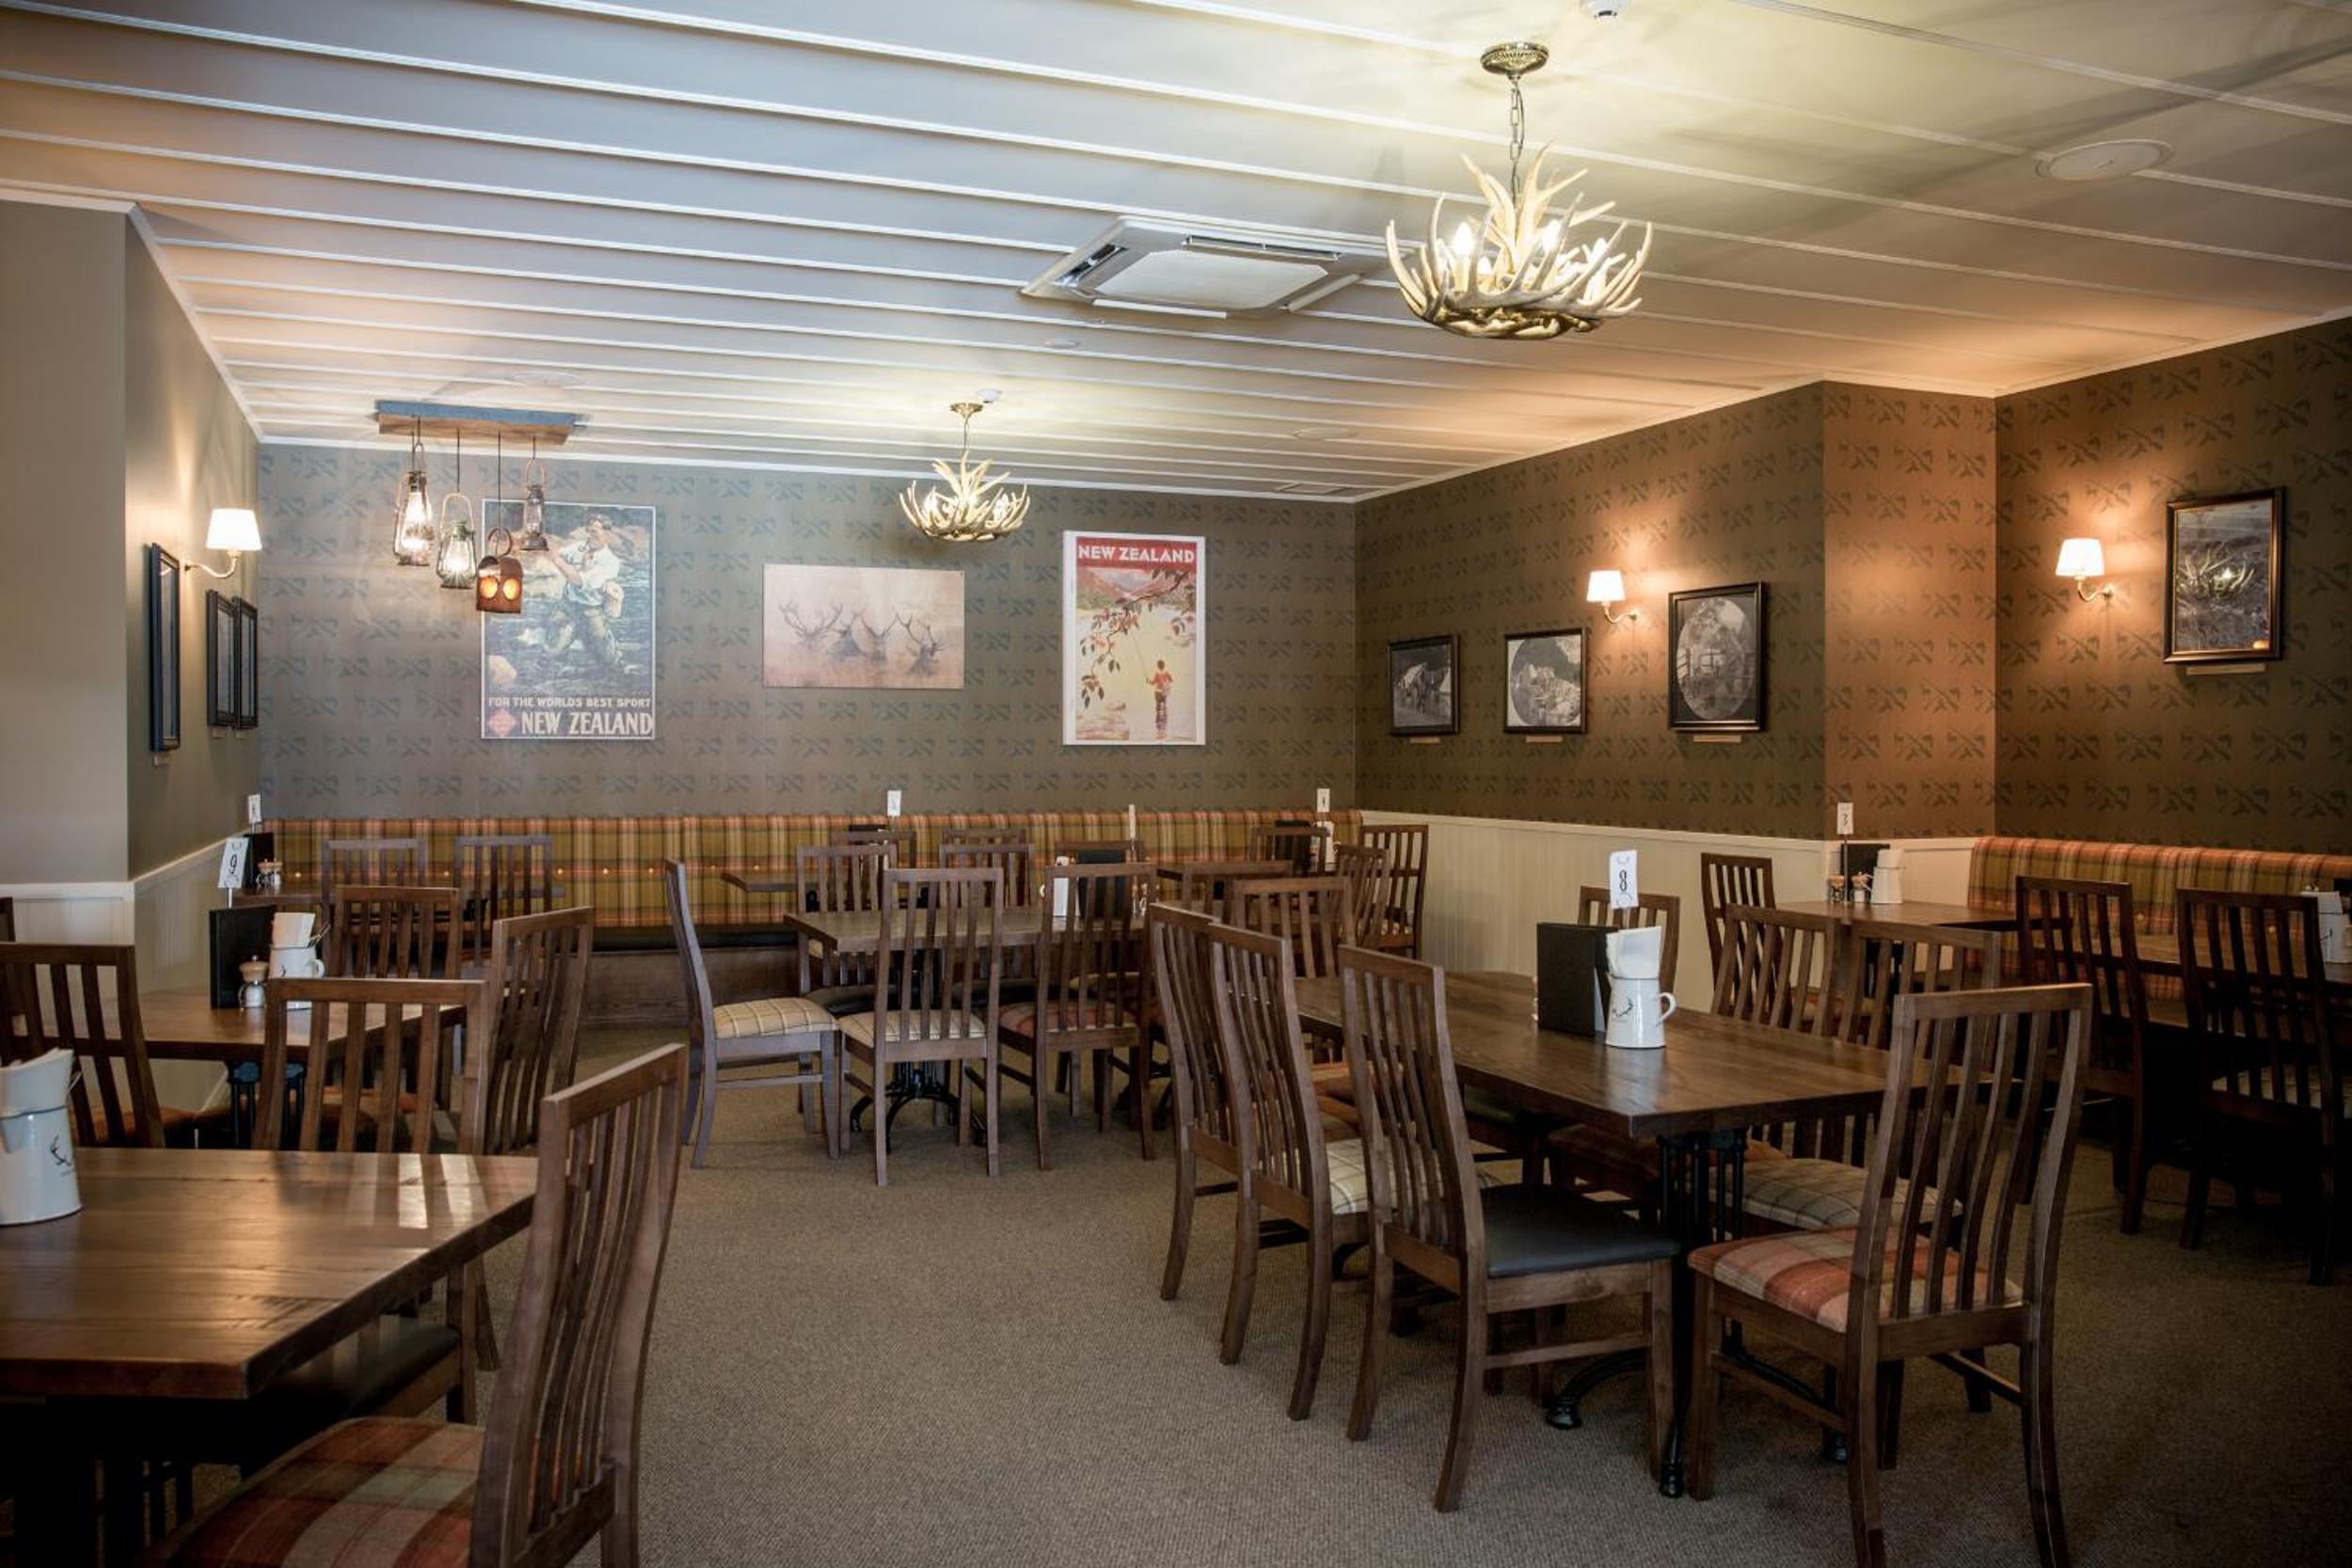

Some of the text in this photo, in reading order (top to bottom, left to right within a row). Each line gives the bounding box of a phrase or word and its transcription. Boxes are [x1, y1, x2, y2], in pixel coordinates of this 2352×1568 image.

[1078, 545, 1195, 562] NEW ZEALAND
[488, 697, 509, 707] FOR
[514, 697, 533, 707] THE
[586, 698, 612, 708] BEST
[616, 698, 651, 708] SPORT
[521, 711, 562, 735] NEW
[569, 712, 653, 735] ZEALAND
[228, 853, 238, 875] 9
[1619, 869, 1628, 892] 8
